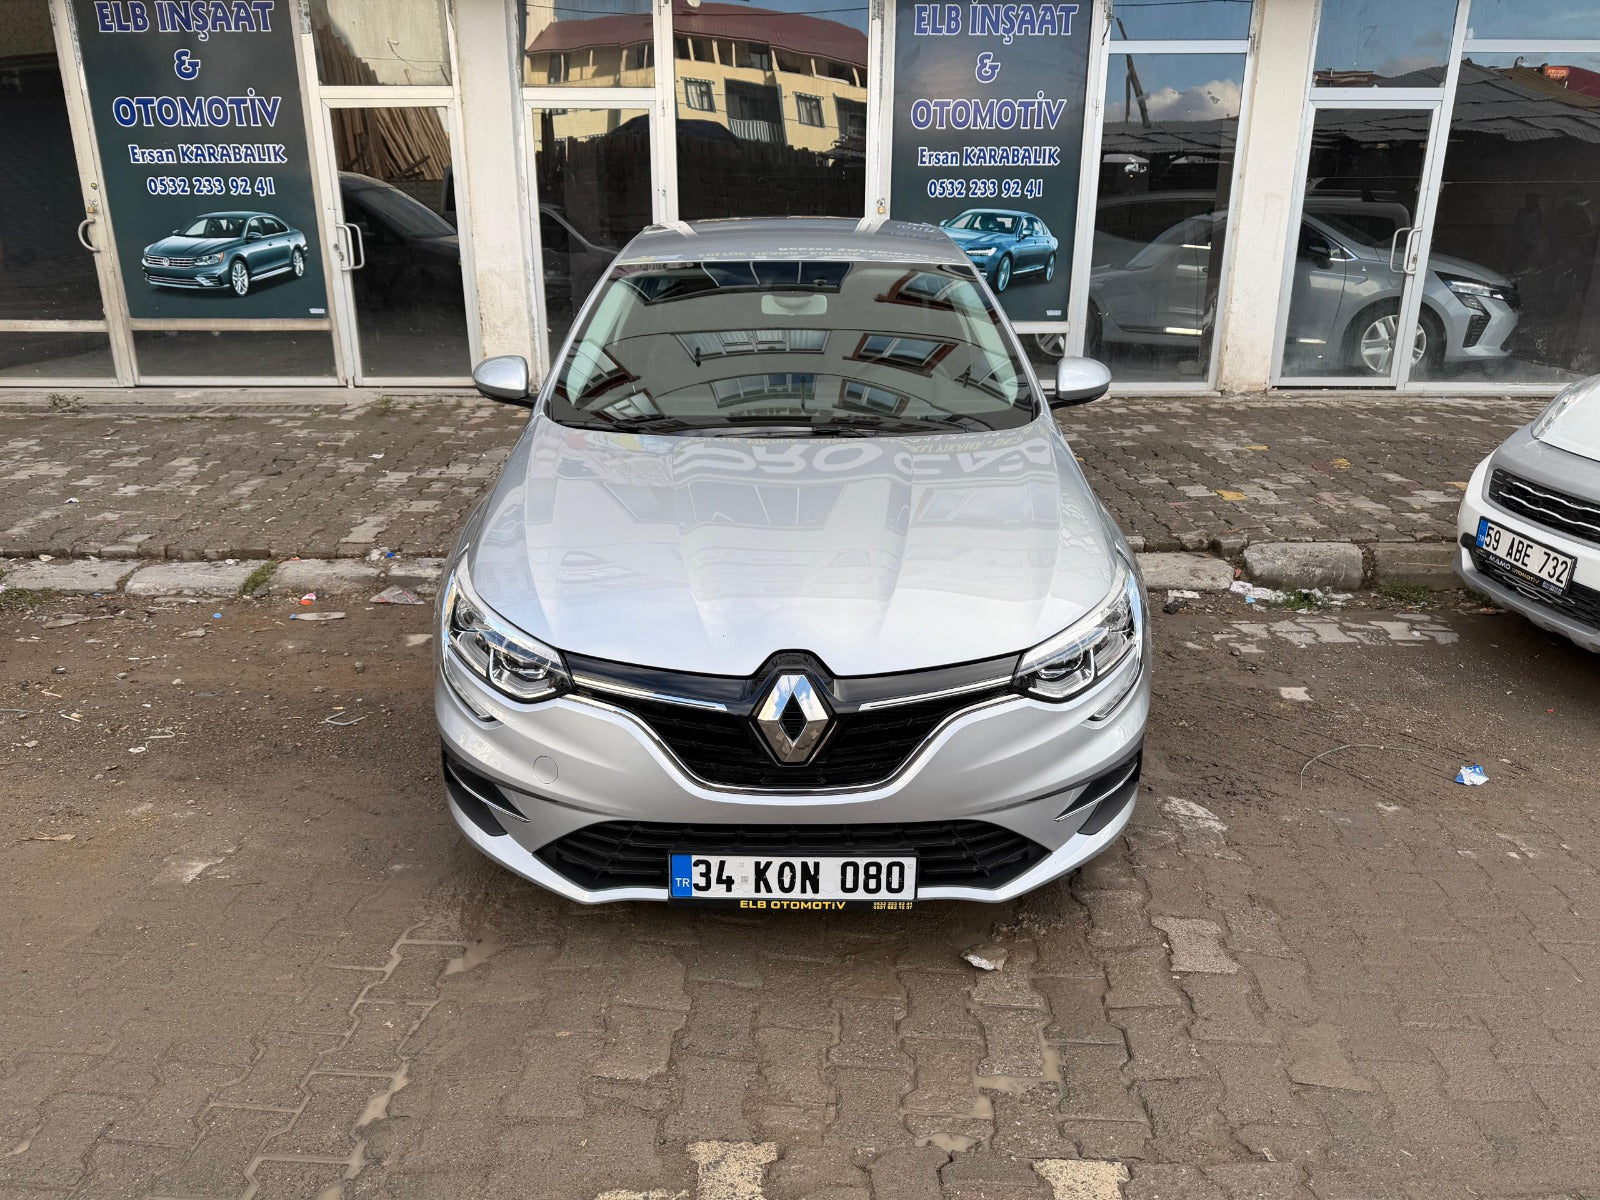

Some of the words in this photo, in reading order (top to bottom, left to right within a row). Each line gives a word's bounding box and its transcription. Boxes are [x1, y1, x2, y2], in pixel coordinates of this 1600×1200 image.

[95, 1, 150, 33] ELB
[914, 4, 962, 36] ELB
[968, 0, 1079, 45] İNŞAAT
[174, 49, 200, 80] &
[975, 52, 1001, 83] &
[112, 88, 282, 128] OTOMOTİV
[911, 90, 1067, 130] OTOMOTİV
[128, 144, 177, 164] Ersan
[178, 143, 288, 164] KARABALIK
[918, 147, 959, 166] Ersan
[962, 146, 1061, 166] KARABALIK
[147, 177, 190, 195] 0532
[193, 177, 225, 194] 233
[229, 177, 251, 195] 92
[254, 177, 276, 197] 41
[927, 179, 966, 198] 0532
[969, 179, 998, 198] 233
[1001, 179, 1022, 198] 92
[1024, 179, 1043, 199] 41
[1485, 526, 1501, 551] 59
[1506, 537, 1533, 567] ABE
[1538, 551, 1568, 584] 732
[674, 877, 690, 888] TR
[692, 859, 735, 893] 34
[754, 860, 820, 895] KON
[840, 860, 905, 895] 080
[740, 900, 767, 909] ELB
